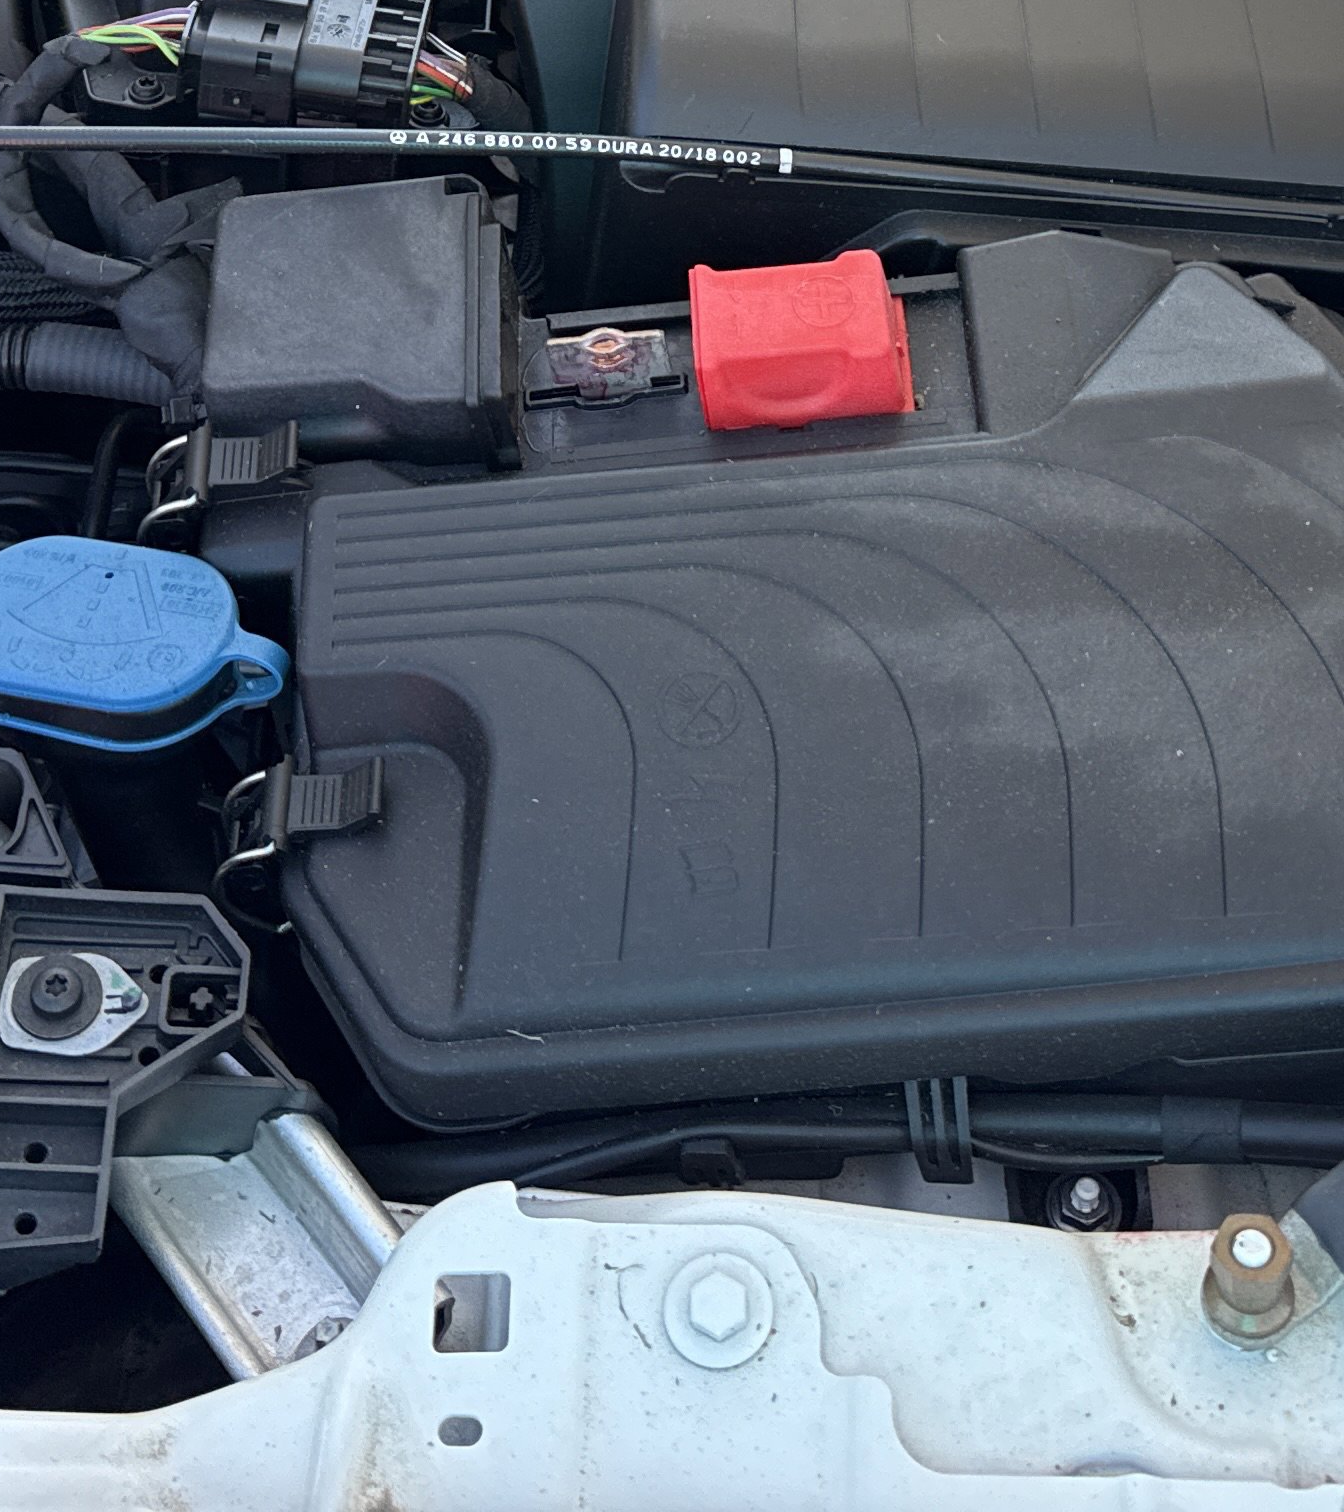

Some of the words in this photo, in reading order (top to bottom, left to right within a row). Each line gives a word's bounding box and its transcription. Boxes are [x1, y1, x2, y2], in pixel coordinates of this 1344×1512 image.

[415, 133, 430, 144] A
[438, 132, 476, 146] 246
[484, 134, 524, 148] 880
[531, 135, 558, 151] 00
[565, 137, 593, 152] 59
[597, 140, 654, 157] DURA
[659, 143, 717, 163] 20/18
